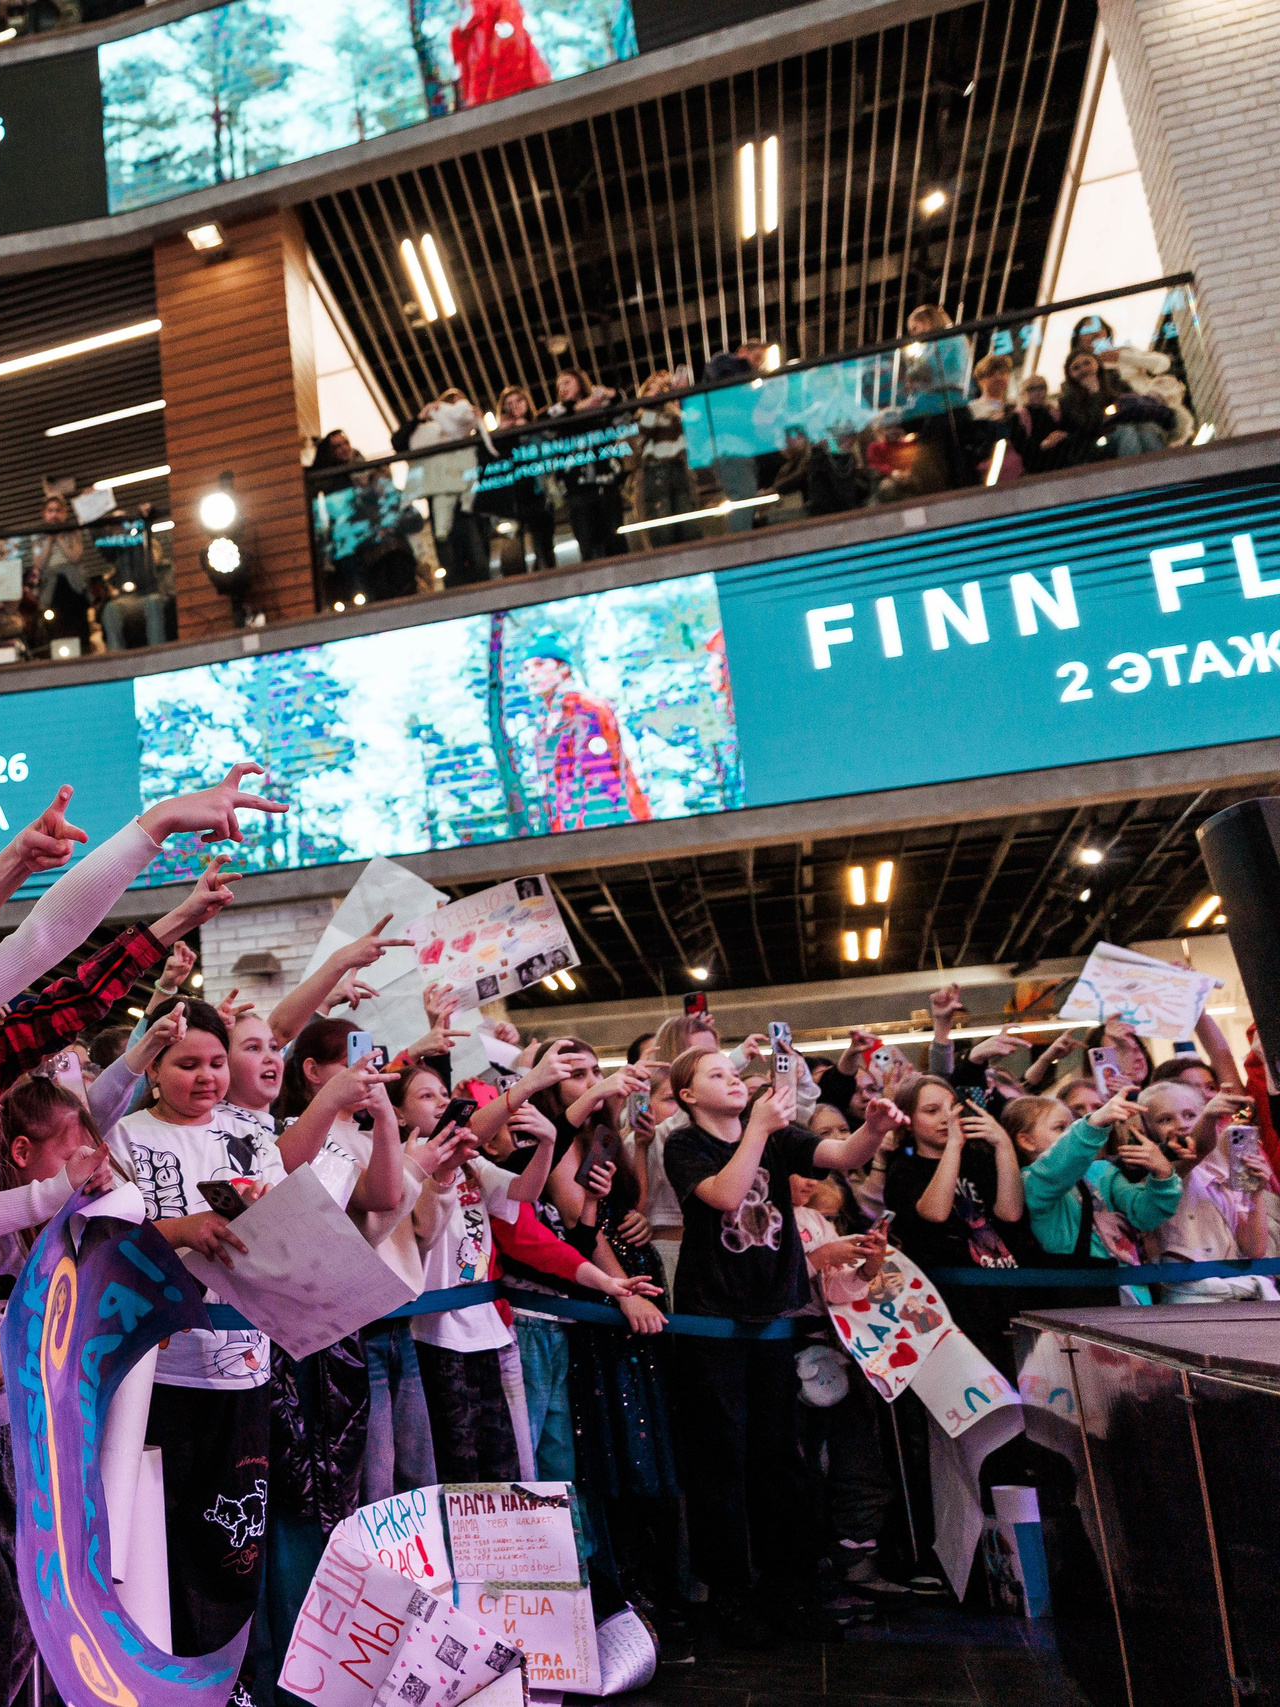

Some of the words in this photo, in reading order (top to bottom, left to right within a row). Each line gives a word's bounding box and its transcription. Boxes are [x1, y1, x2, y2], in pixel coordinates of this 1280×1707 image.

[805, 566, 1080, 670] FINN
[1056, 661, 1094, 703] 2
[1107, 629, 1280, 693] ЭТАЖ
[449, 1494, 496, 1516] МАМА
[284, 1538, 372, 1694] СТЕШО
[477, 1593, 555, 1616] СТЕША
[503, 1618, 517, 1634] И
[339, 1598, 405, 1690] МЫ
